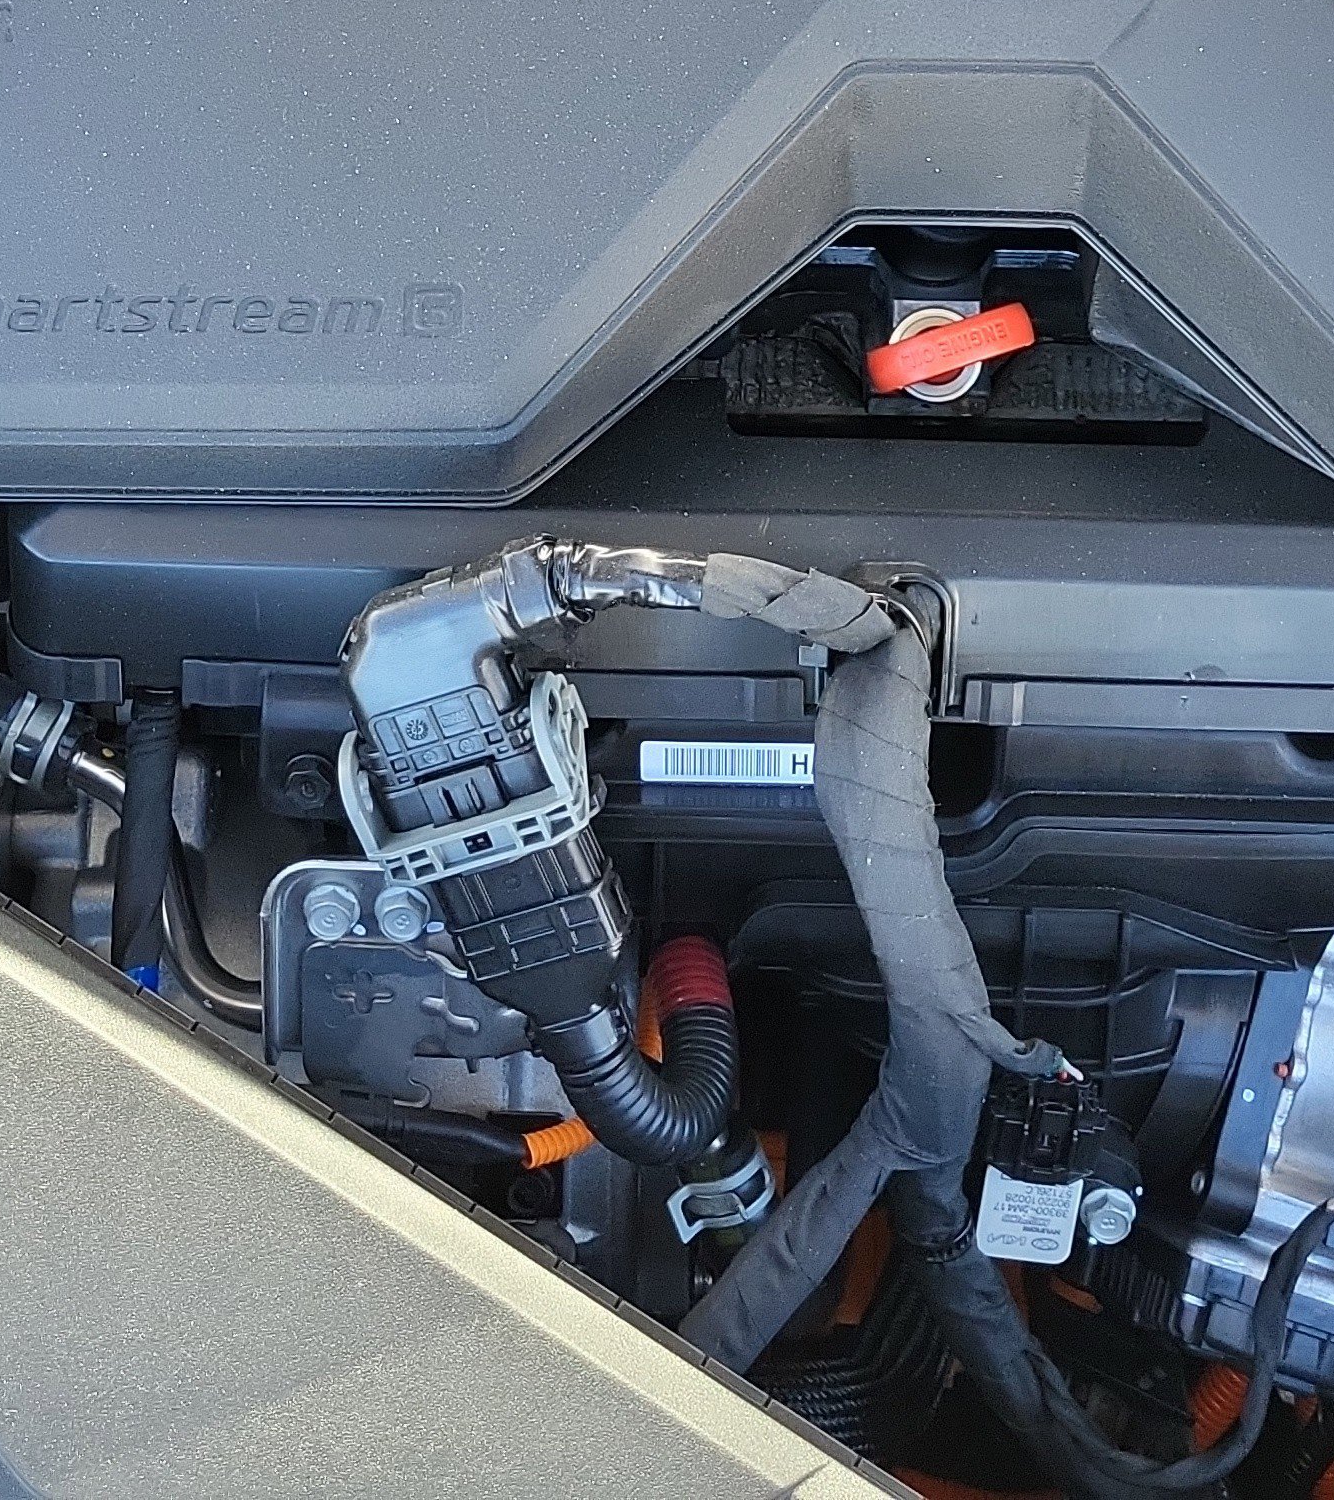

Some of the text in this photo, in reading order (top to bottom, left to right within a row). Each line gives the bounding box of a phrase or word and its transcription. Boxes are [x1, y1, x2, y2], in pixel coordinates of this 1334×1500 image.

[898, 319, 1010, 372] ENGINE OIL
[791, 753, 813, 775] H
